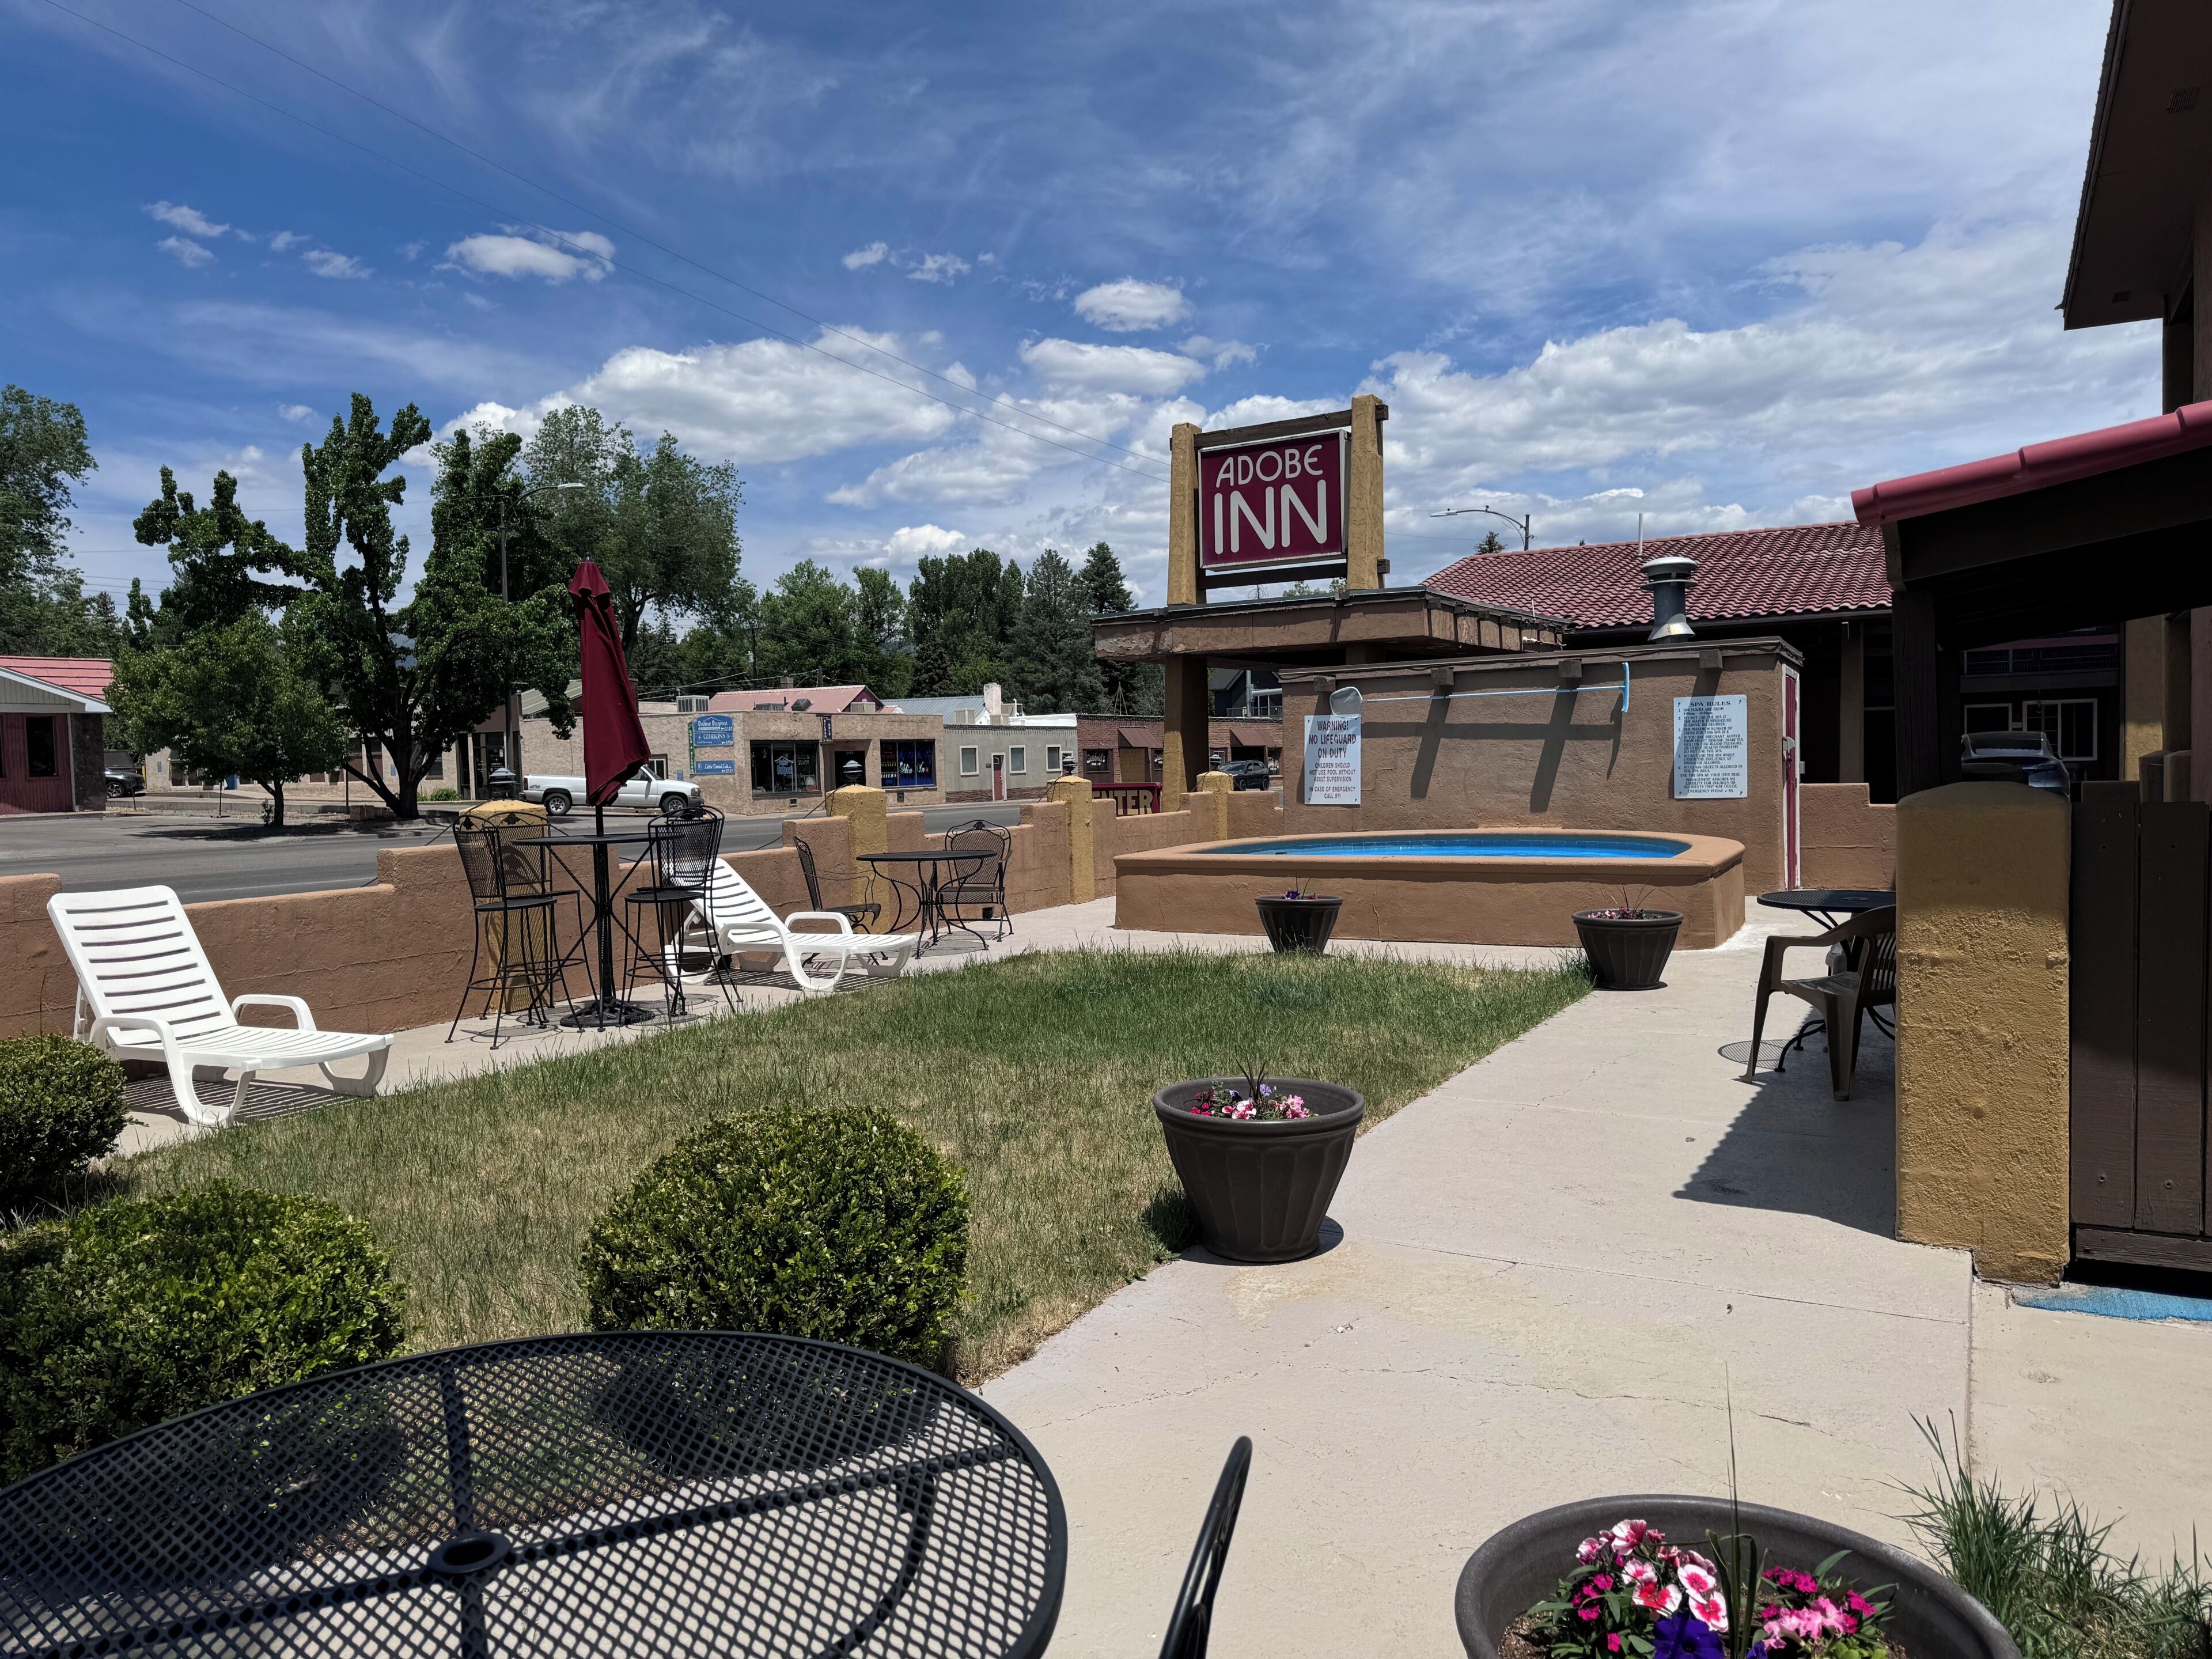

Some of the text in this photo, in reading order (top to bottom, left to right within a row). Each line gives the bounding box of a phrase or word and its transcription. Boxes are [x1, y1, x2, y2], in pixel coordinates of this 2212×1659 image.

[1216, 444, 1323, 488] ADOBE
[1214, 479, 1327, 555] INN
[1317, 721, 1348, 731] WARNING!
[1309, 734, 1357, 744] NO LIFEGUARD
[1318, 748, 1347, 758] ON DUTY
